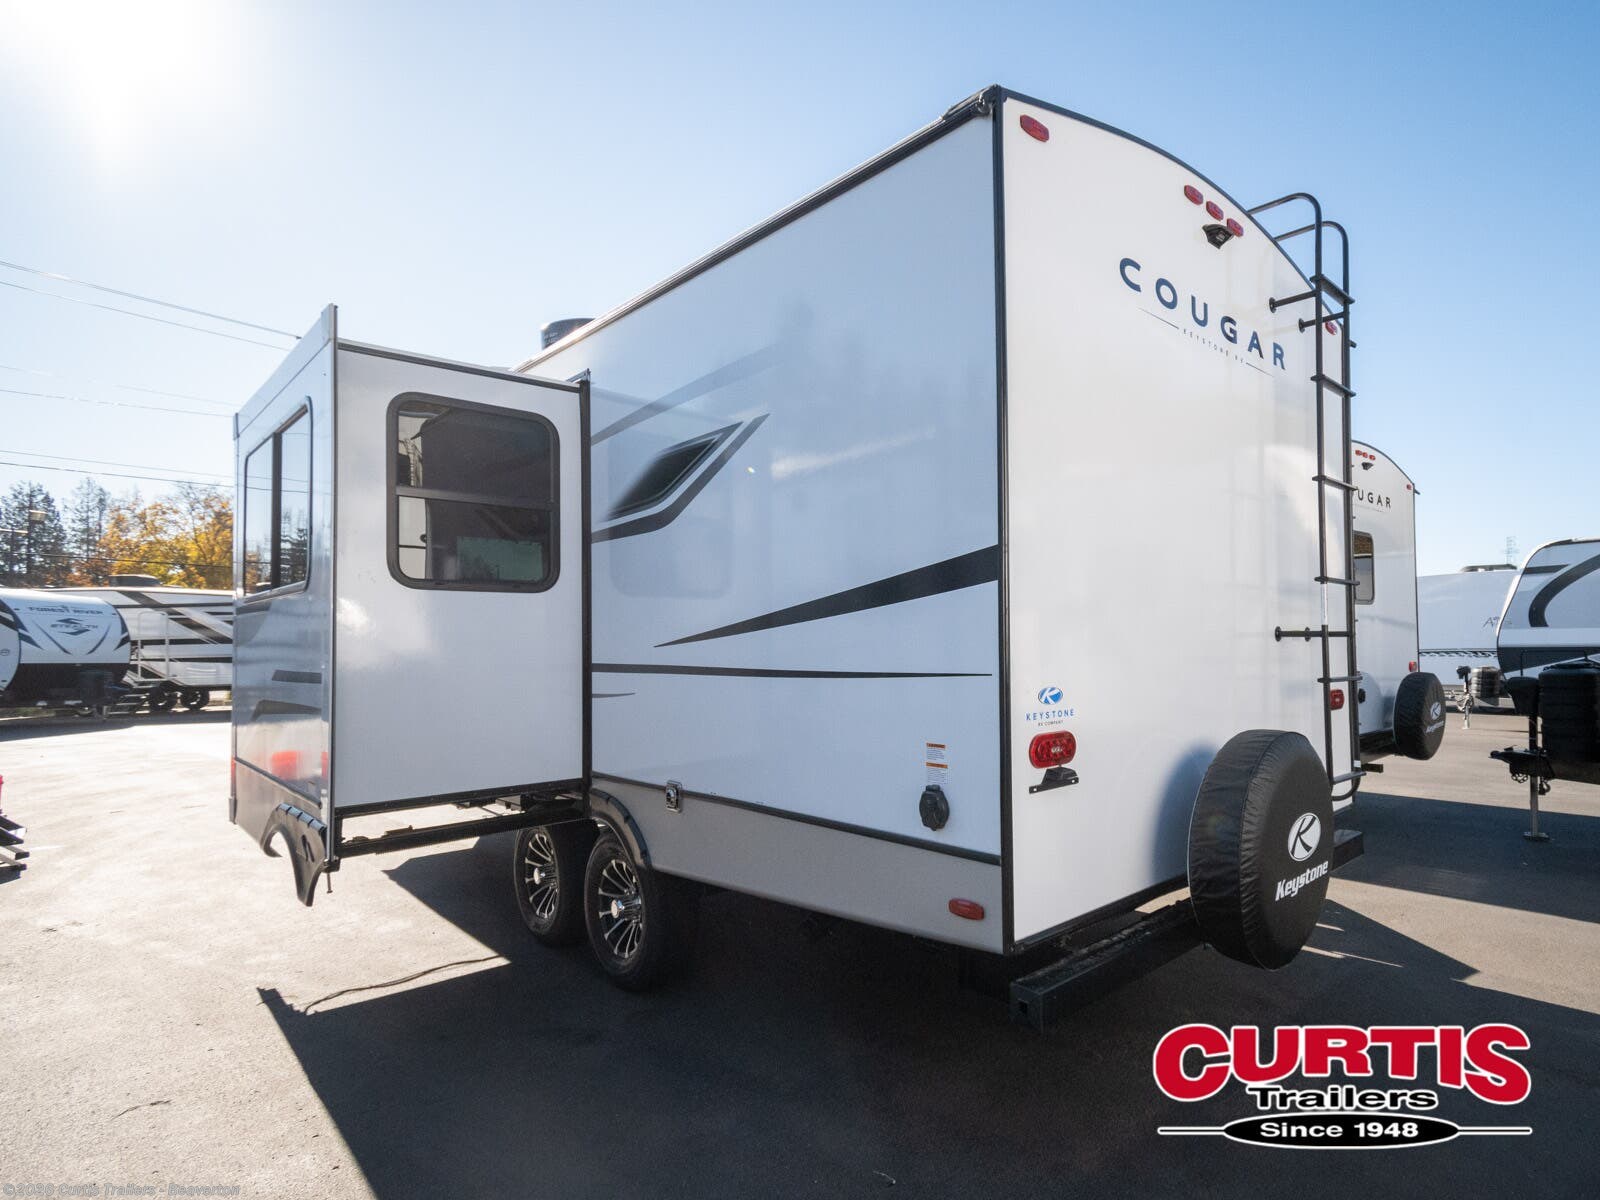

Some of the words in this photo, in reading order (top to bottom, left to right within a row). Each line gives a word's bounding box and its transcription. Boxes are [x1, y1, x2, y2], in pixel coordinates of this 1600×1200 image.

[1119, 257, 1286, 371] COUGAR
[1357, 489, 1392, 509] UGAR
[1025, 709, 1075, 721] KEYSTONE
[1275, 860, 1329, 901] Keystone
